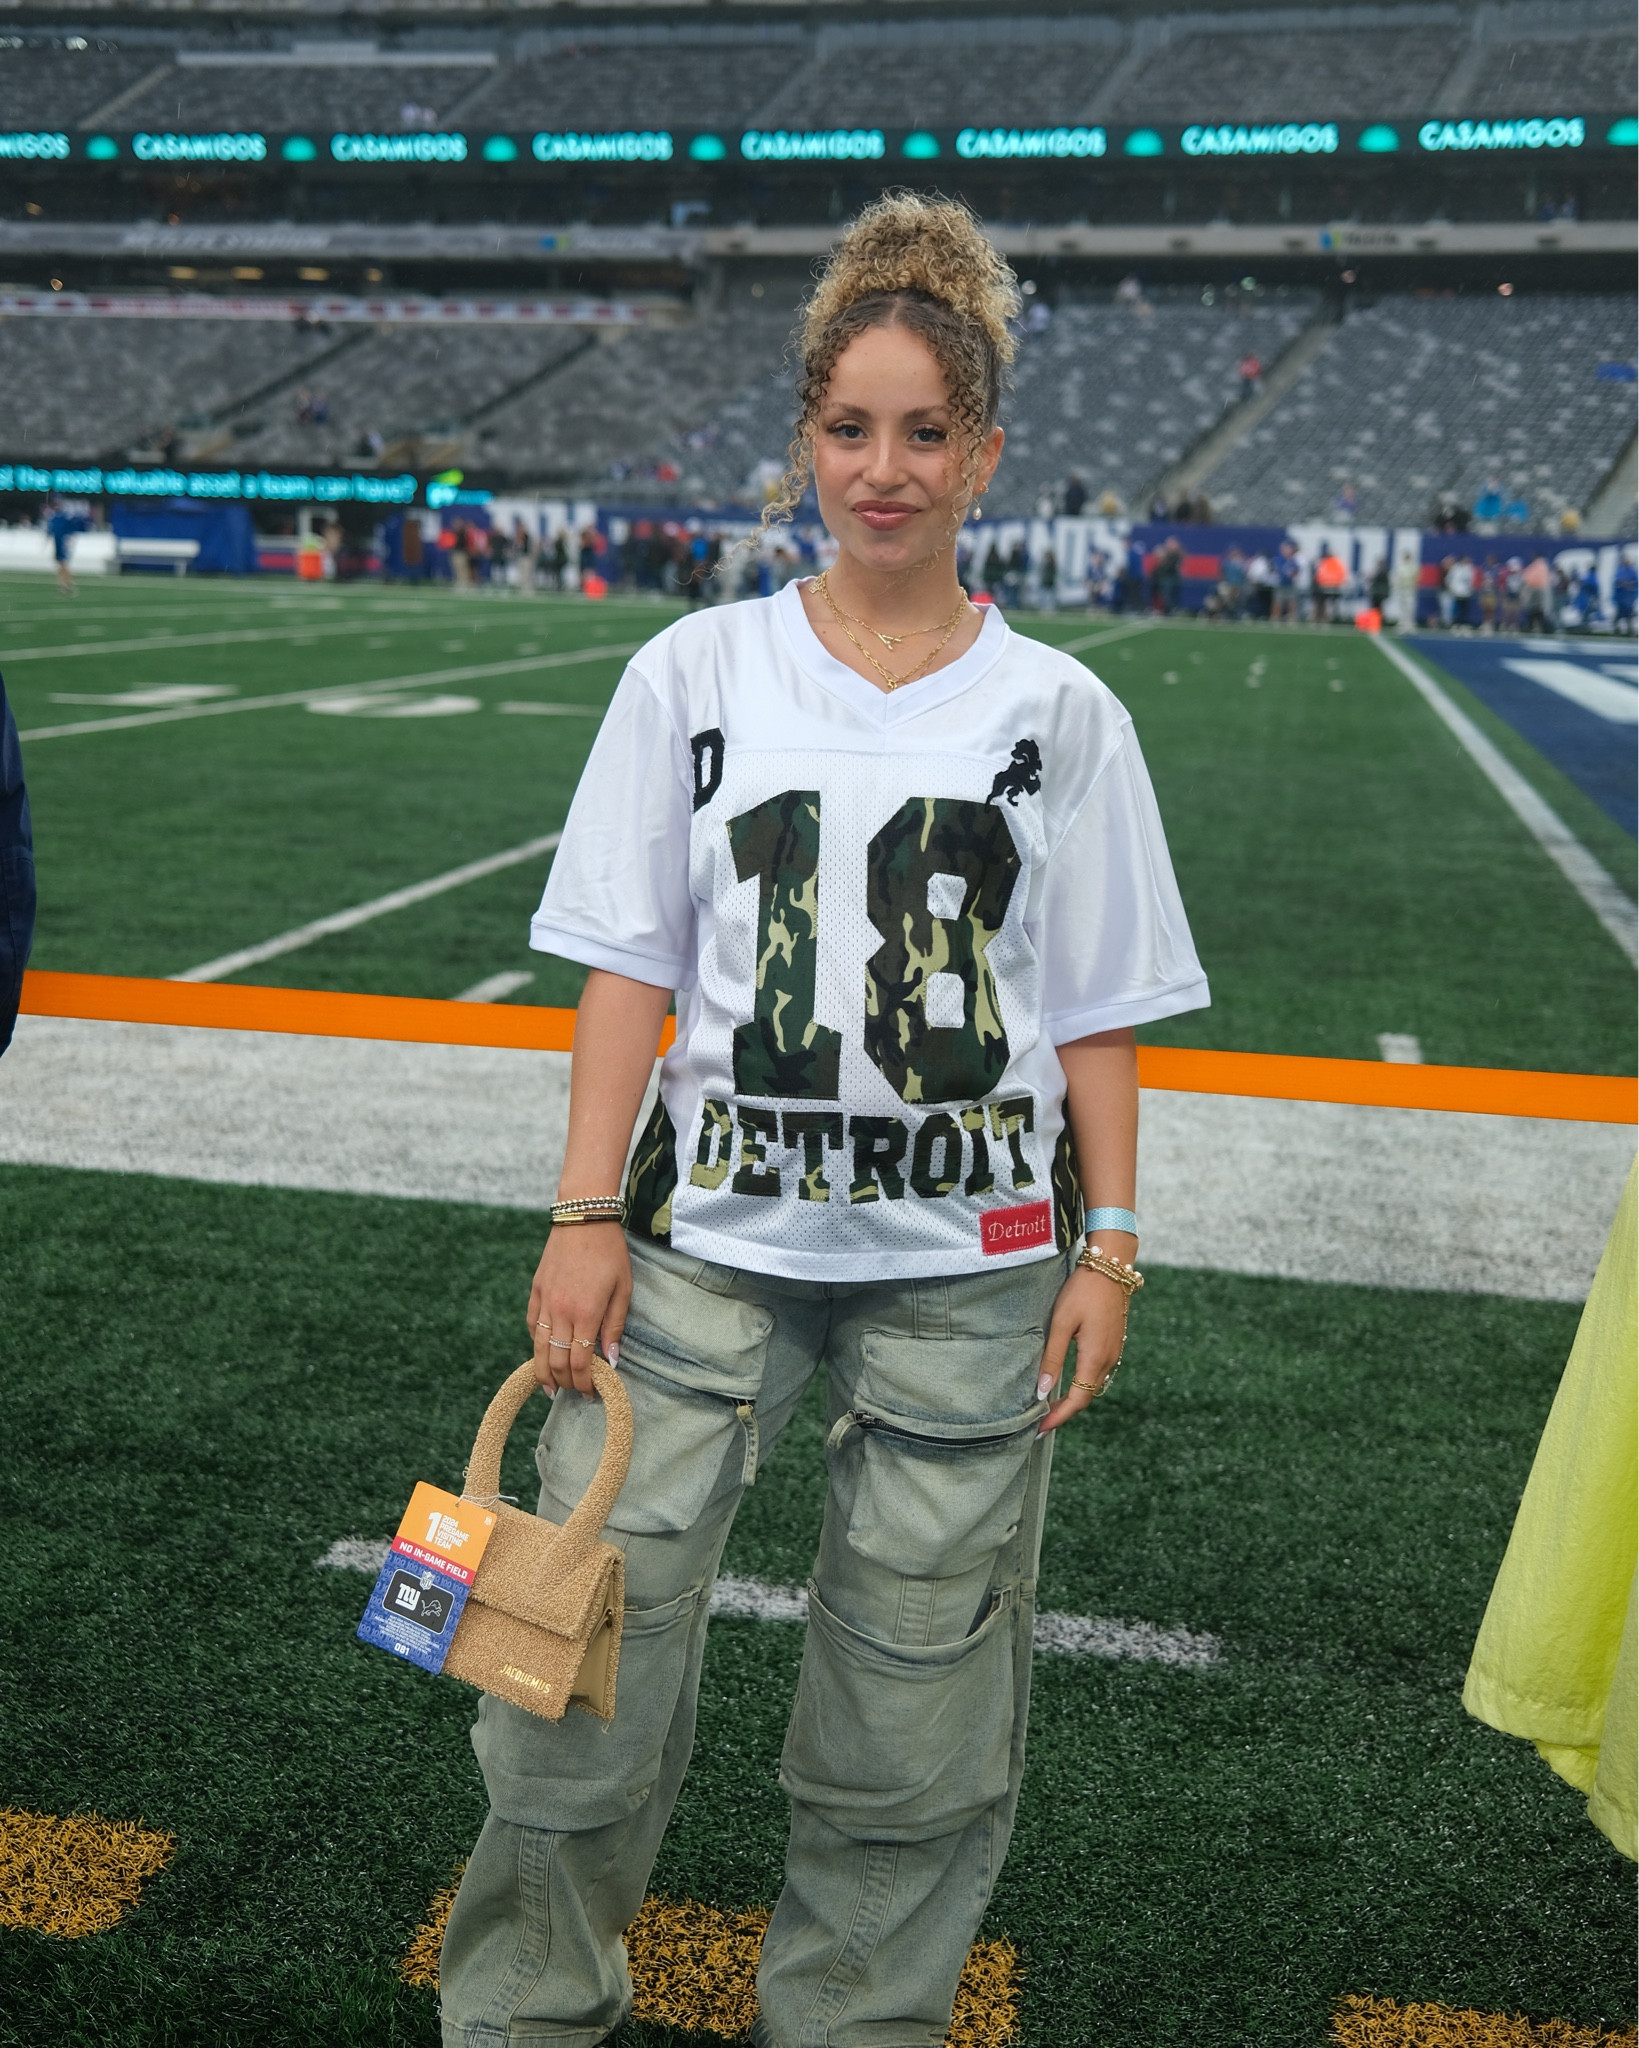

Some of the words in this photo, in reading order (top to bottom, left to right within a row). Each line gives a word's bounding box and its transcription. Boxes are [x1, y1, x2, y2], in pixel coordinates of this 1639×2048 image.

[132, 132, 267, 161] CASAMIGOS
[330, 132, 468, 162] CASAMIGOS
[532, 131, 673, 162] CASAMIGOS
[740, 129, 886, 160] CASAMIGOS
[955, 126, 1107, 159] CASAMIGOS
[1180, 122, 1340, 157] CASAMIGOS
[1418, 116, 1586, 152] CASAMIGOS
[725, 789, 1023, 1104] 18
[689, 1096, 1035, 1205] DETROIT
[988, 1214, 1046, 1242] Detroit
[425, 1511, 443, 1543] 1
[437, 1529, 464, 1547] VISITING
[439, 1522, 470, 1540] PREGAME
[434, 1536, 453, 1551] TEAM
[399, 1541, 414, 1553] NO
[413, 1547, 447, 1569] IN-GAME
[446, 1563, 468, 1580] FIELD
[500, 1663, 551, 1693] JACQUEMUS
